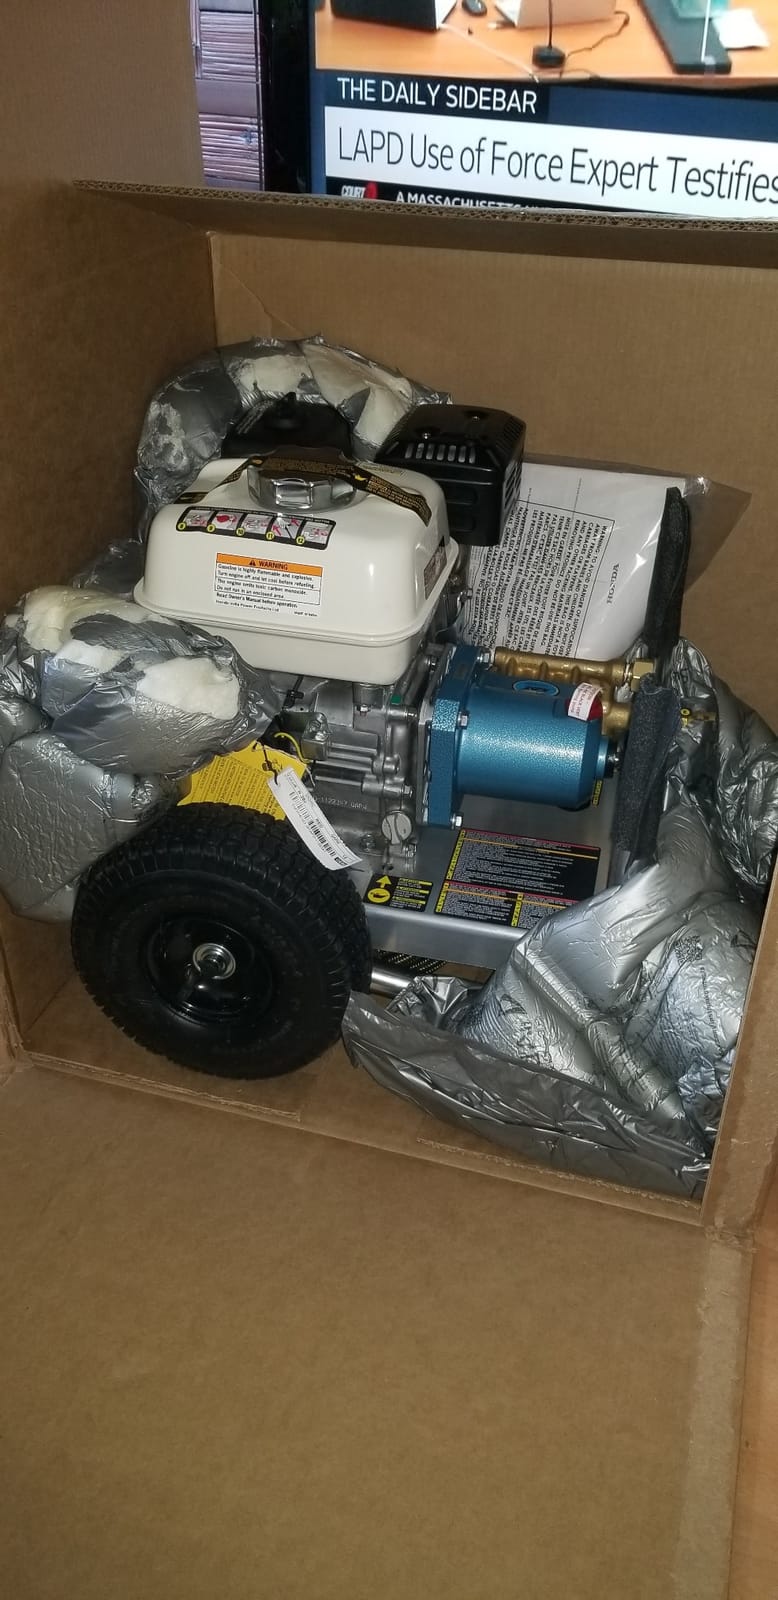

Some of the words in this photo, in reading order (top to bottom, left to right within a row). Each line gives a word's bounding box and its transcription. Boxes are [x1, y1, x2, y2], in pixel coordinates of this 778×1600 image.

[337, 77, 376, 101] THE
[382, 80, 441, 106] DAILY
[446, 85, 537, 114] SIDEBAR
[339, 126, 403, 165] LAPD
[410, 133, 454, 171] Use
[460, 137, 487, 174] of
[491, 140, 563, 182] Force
[570, 148, 659, 196] Expert
[667, 156, 778, 204] Testifies
[341, 185, 366, 199] COURT
[396, 191, 405, 203] A
[510, 506, 524, 538] MANTENGA
[555, 515, 565, 530] TENIR
[579, 520, 587, 533] AND
[539, 533, 546, 543] CE
[553, 531, 560, 539] CE
[561, 531, 567, 539] EN
[567, 519, 580, 550] REMOVING
[580, 521, 593, 554] CARRIAGES
[591, 523, 600, 541] AWAY
[507, 539, 515, 551] ESTA
[550, 540, 558, 552] SAC
[585, 541, 594, 558] FROM
[545, 553, 554, 569] HORS
[570, 548, 579, 565] OTHER
[577, 555, 583, 564] OR
[591, 555, 597, 563] TO
[218, 563, 237, 571] Gasoline
[243, 567, 256, 575] highly
[257, 569, 281, 577] flammable
[259, 560, 288, 570] WARNING
[549, 561, 558, 577] POUR
[579, 559, 588, 578] BABIES
[527, 570, 535, 580] PAS
[543, 569, 549, 577] DE
[560, 566, 572, 592] PACKING
[584, 564, 594, 583] AVOID
[524, 581, 531, 589] UN
[539, 577, 546, 585] LA
[554, 578, 561, 588] DO
[574, 578, 582, 592] AND
[533, 585, 544, 605] PORTÉE
[577, 584, 588, 607] DANGER
[540, 596, 548, 609] TOUT
[552, 593, 565, 622] MATERIALS
[566, 593, 578, 621] CHILDREN.
[516, 610, 524, 623] JETER
[531, 606, 539, 616] DES
[560, 606, 568, 619] BAG
[575, 609, 581, 617] OF
[535, 610, 544, 629] RISQUE
[513, 624, 520, 632] CE
[543, 621, 551, 632] THIS
[555, 626, 563, 638] NOT
[564, 622, 570, 631] DO
[563, 618, 579, 656] SUFFOCATION
